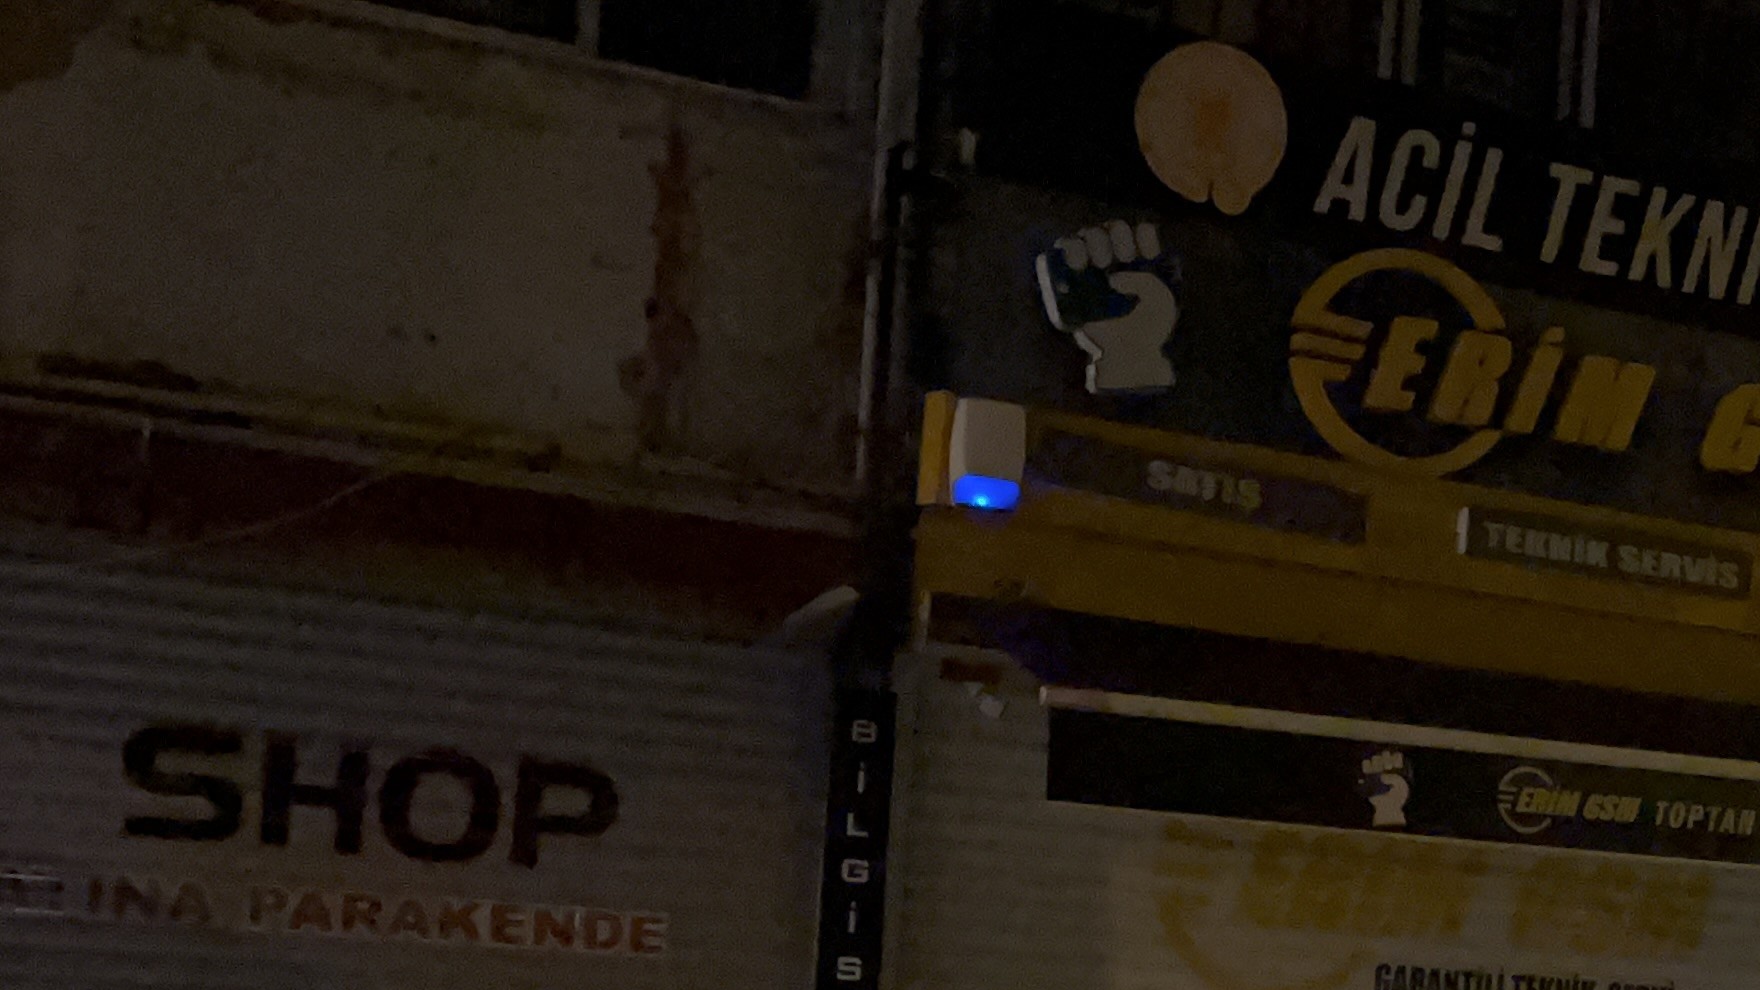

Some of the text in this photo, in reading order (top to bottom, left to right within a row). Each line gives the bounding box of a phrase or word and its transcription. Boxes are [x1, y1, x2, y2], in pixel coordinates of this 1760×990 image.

[1312, 116, 1504, 252] ACİL
[1482, 520, 1741, 590] TEKNİK SERVİS
[123, 722, 620, 868] SHOP
[1654, 800, 1757, 837] TOPTAN
[250, 884, 670, 956] PARAKENDE
